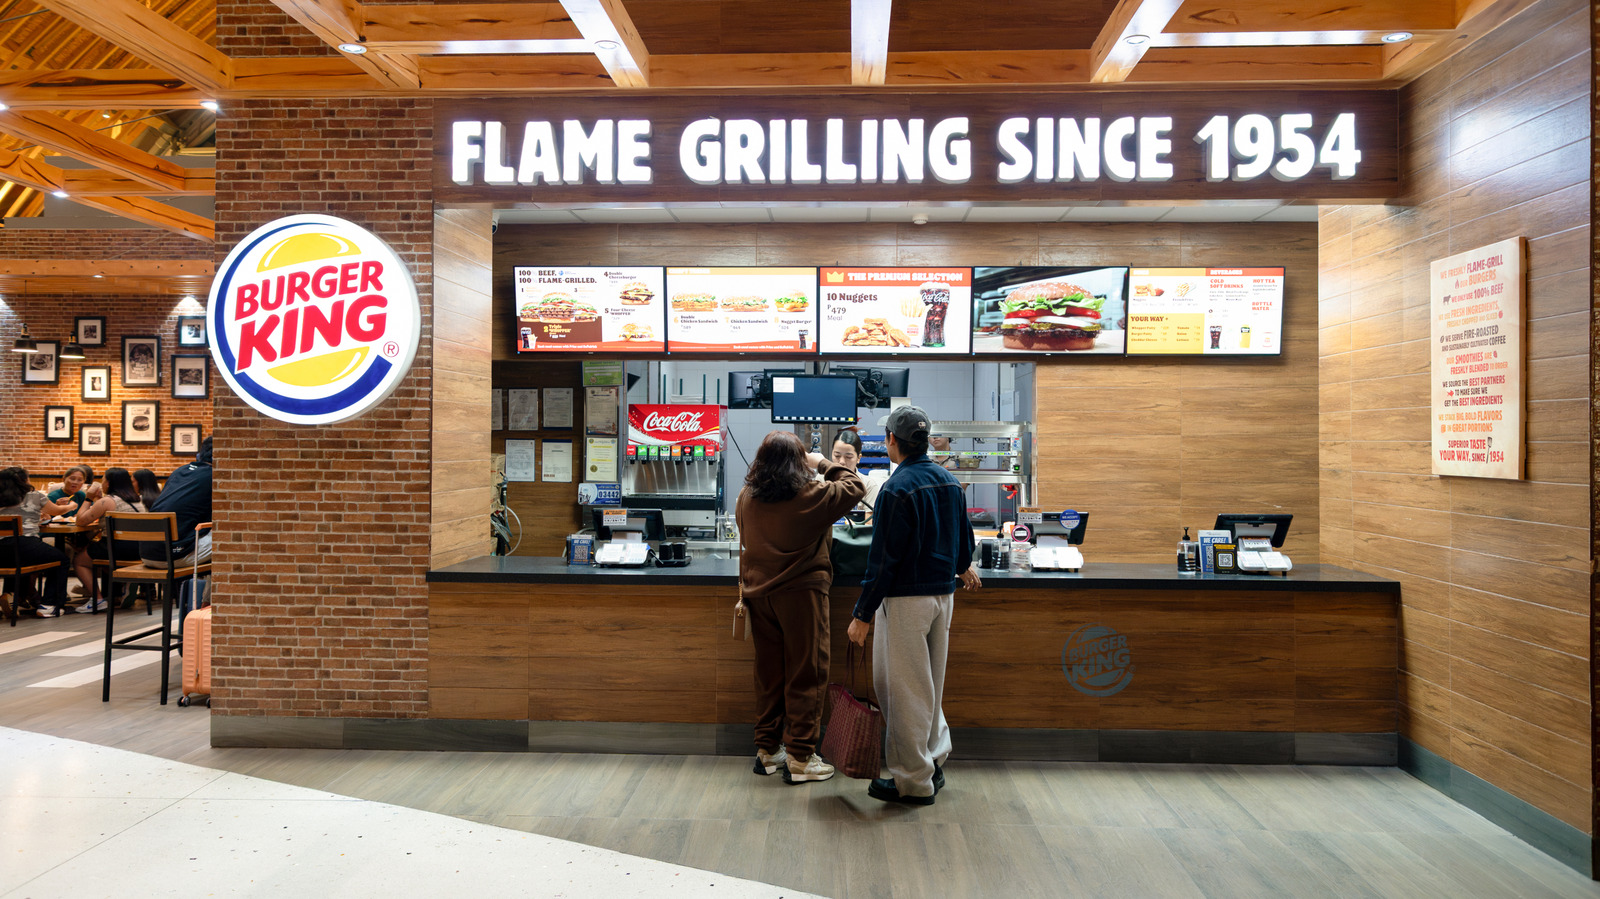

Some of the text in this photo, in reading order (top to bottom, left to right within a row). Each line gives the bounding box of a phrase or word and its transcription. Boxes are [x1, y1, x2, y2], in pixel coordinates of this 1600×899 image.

[452, 113, 1362, 185] FLAME GRILLING SINCE 1954
[1448, 266, 1466, 277] FRESHLY
[1467, 255, 1503, 273] FLAME-GRILL
[848, 273, 962, 281] THE PREMIUM SELECTION
[1469, 269, 1496, 286] BURGERS
[235, 261, 383, 321] BURGER
[1474, 287, 1490, 299] 100%
[1491, 283, 1504, 295] BEEF
[827, 293, 878, 303] 10 Nuggets
[1451, 306, 1465, 318] FRESH
[674, 316, 678, 324] 6
[237, 294, 388, 371] KING
[1452, 333, 1463, 341] SERVE
[1464, 325, 1498, 339] FIRE-ROASTED
[1489, 335, 1506, 345] COFFEE
[1455, 352, 1483, 364] SMOOTHIES
[1451, 365, 1468, 375] FRESHLY
[1469, 363, 1489, 373] BLENDED
[1469, 377, 1480, 386] BEST
[1481, 375, 1505, 385] PARTNERS
[1459, 397, 1469, 406] BEST
[1470, 395, 1503, 405] INGREDIENTS
[643, 411, 704, 432] Coca-Cola
[1465, 412, 1477, 420] BOLD
[1477, 410, 1502, 421] FLAVORS
[1452, 424, 1467, 432] GREAT
[1468, 423, 1493, 432] PORTIONS
[1448, 439, 1486, 449] SUPERIOR TASTE
[1439, 450, 1504, 463] YOUR WAY, SINCE 1954
[1070, 636, 1127, 663] BURGER
[1072, 649, 1130, 682] KING
